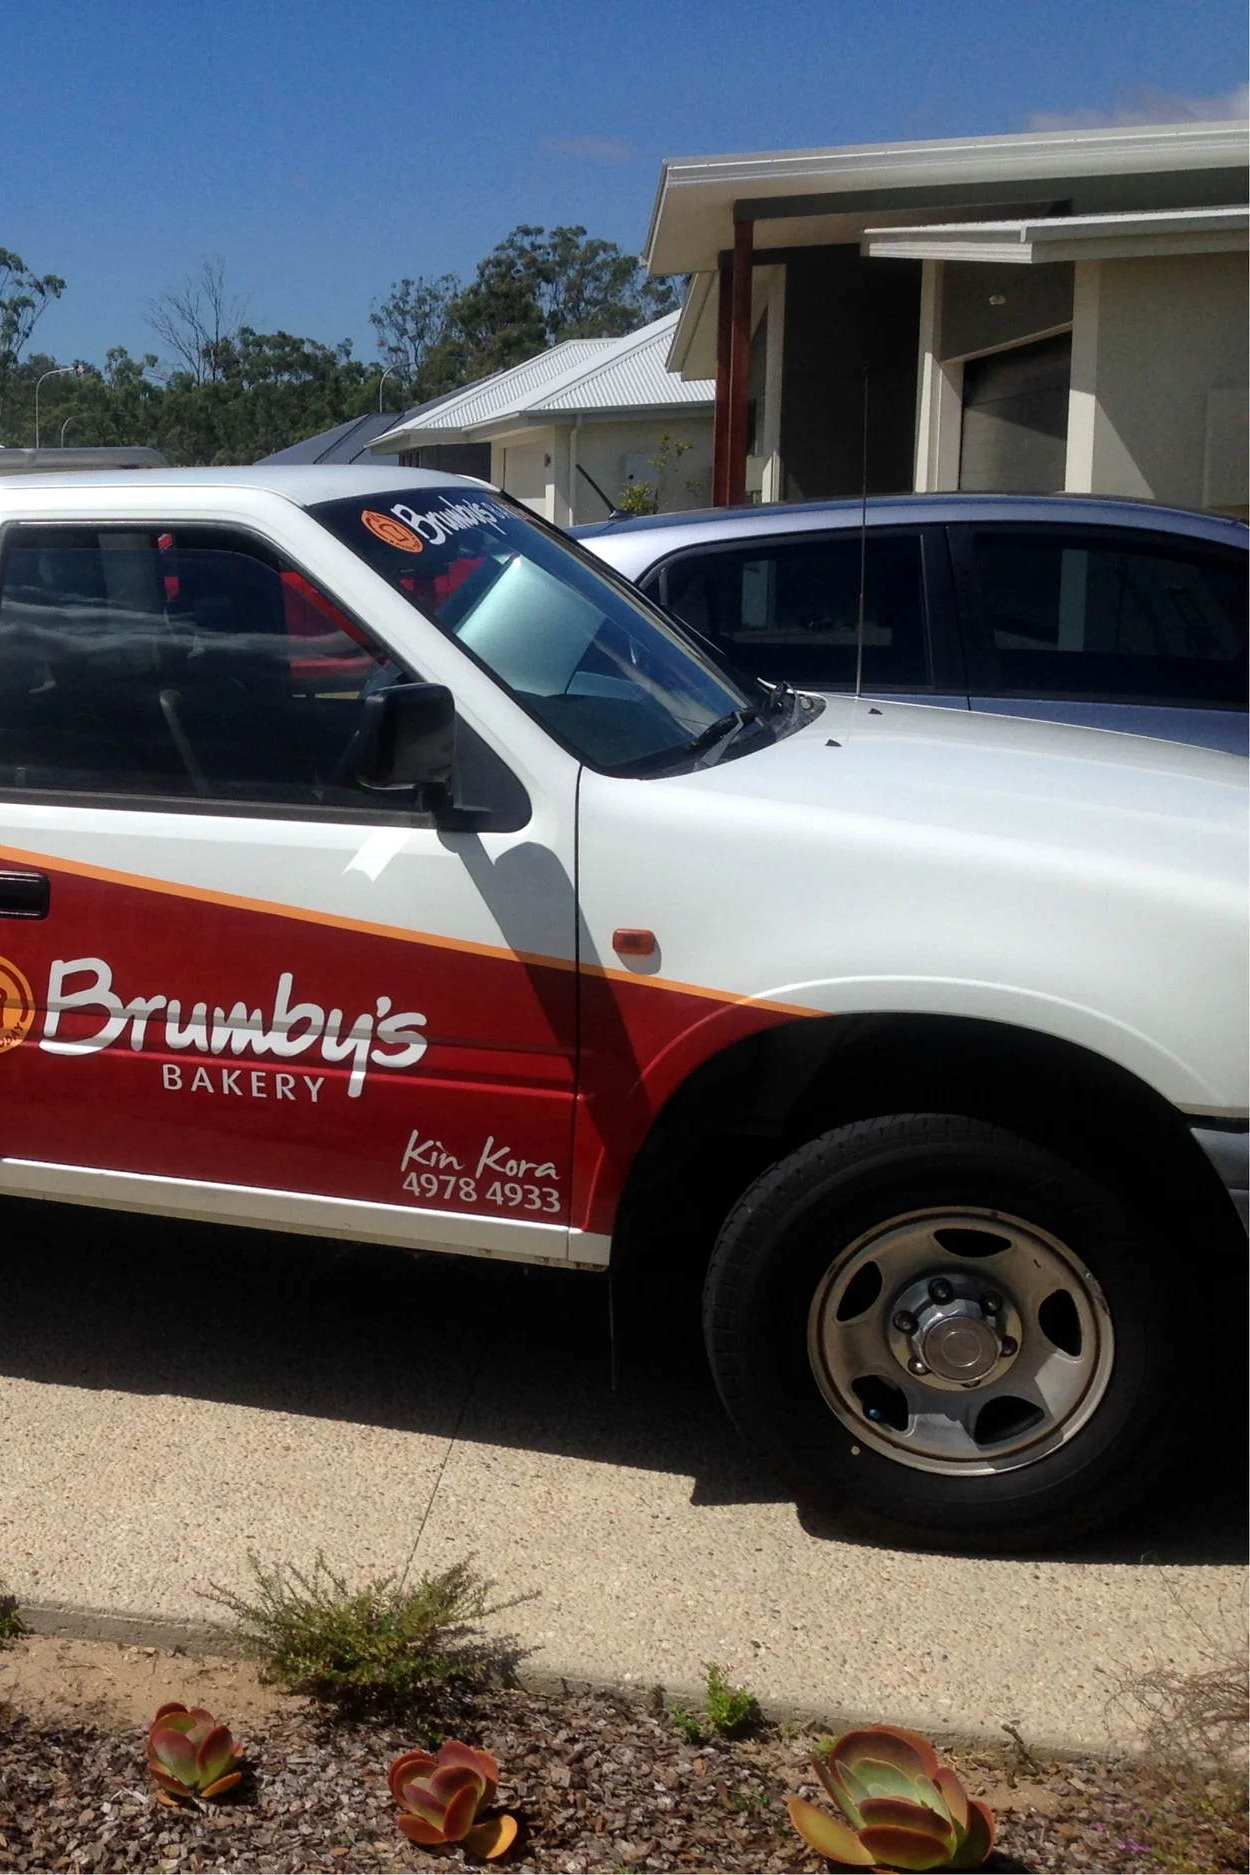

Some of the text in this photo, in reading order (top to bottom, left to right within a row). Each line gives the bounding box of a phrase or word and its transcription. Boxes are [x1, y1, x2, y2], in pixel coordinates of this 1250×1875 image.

[39, 957, 428, 1098] Brumby's
[162, 1064, 325, 1102] BAKERY
[401, 1129, 562, 1180] Kin Kora
[402, 1172, 561, 1213] 4978 4933
